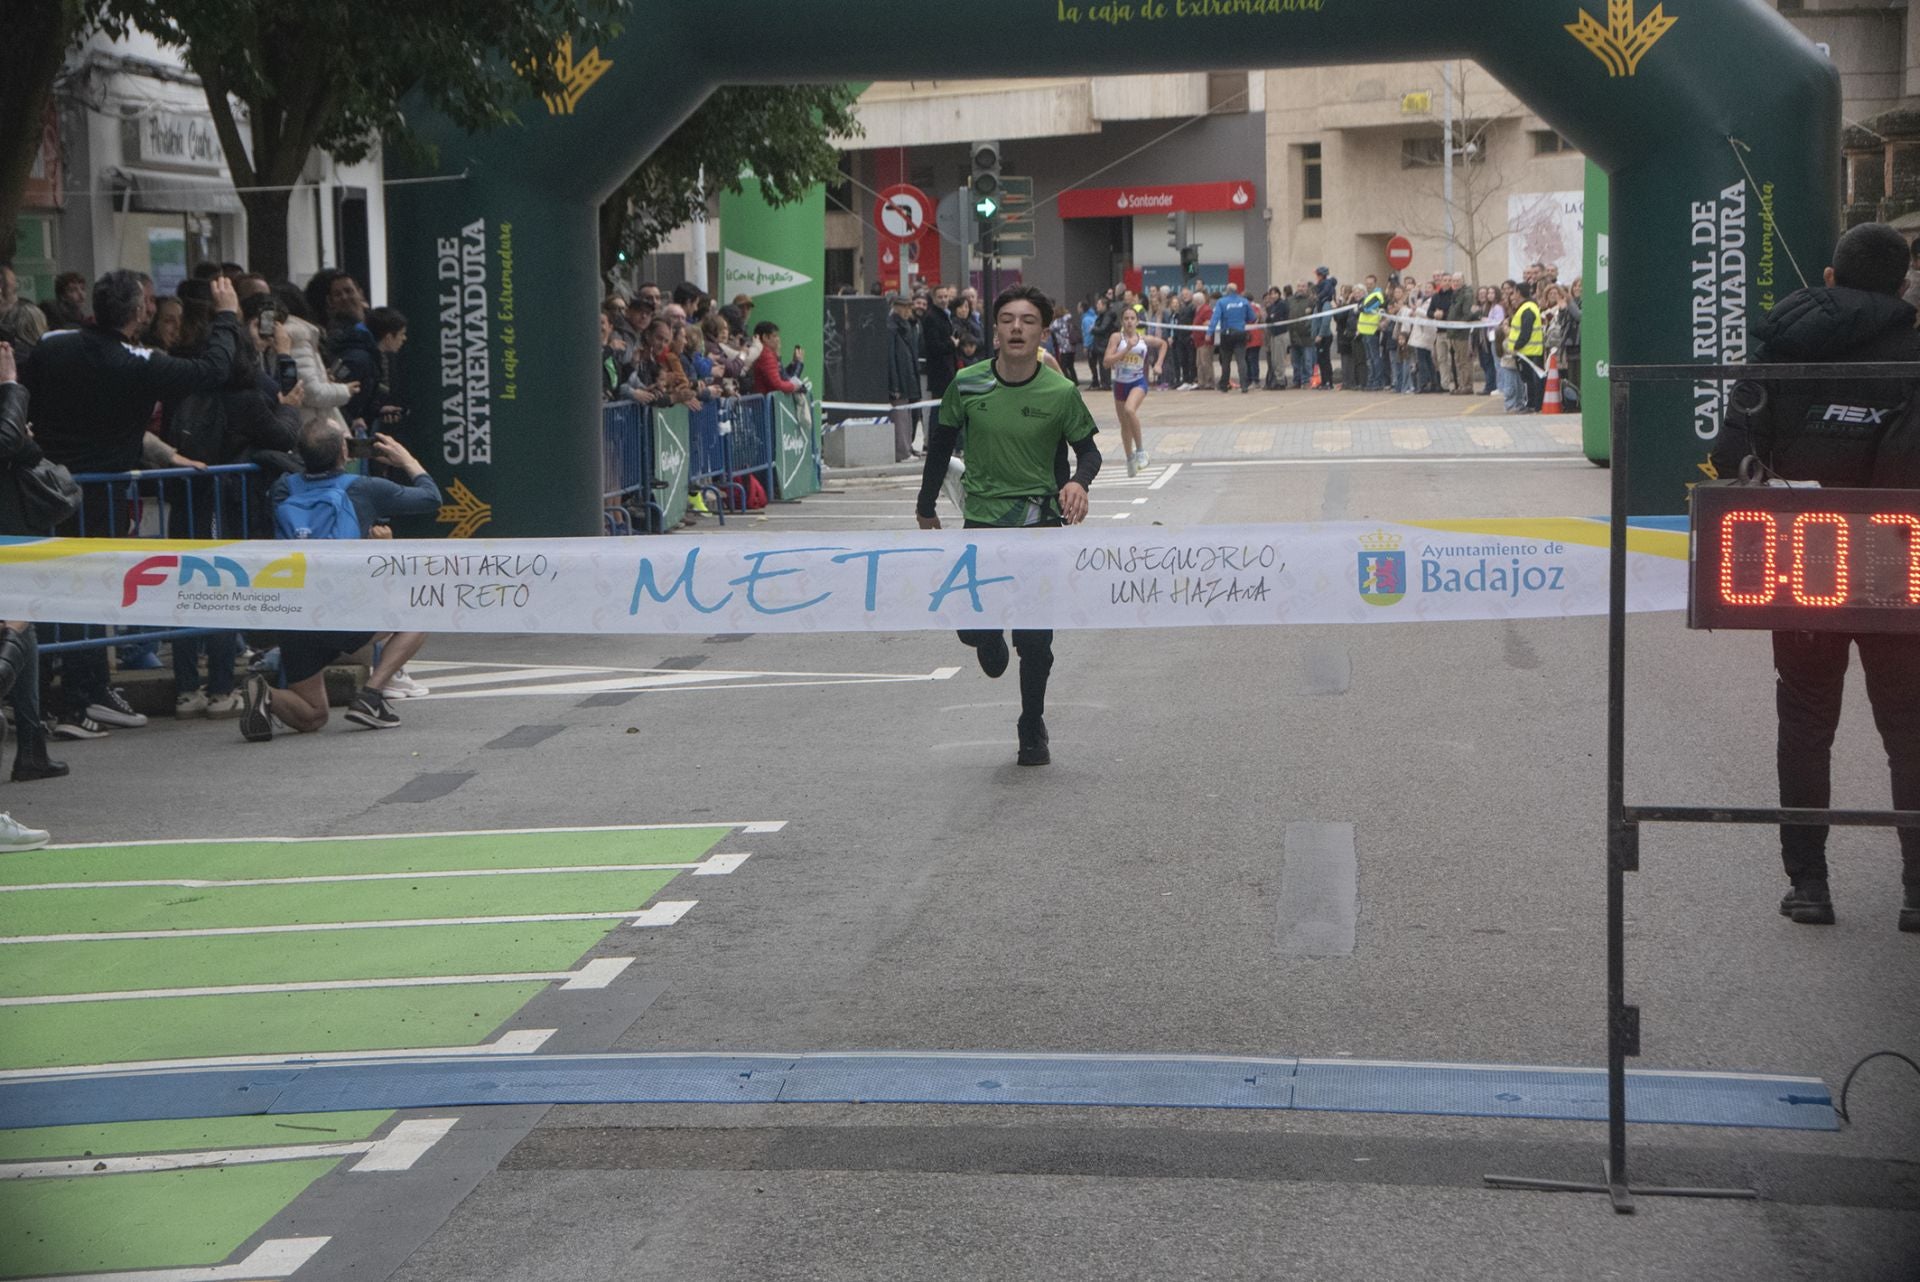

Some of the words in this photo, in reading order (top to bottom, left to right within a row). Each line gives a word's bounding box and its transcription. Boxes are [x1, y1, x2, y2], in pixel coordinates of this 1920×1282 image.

[1088, 0, 1135, 24] caja
[1141, 0, 1169, 19] de
[1128, 193, 1174, 209] Santander
[1691, 200, 1717, 246] DE
[1757, 181, 1774, 286] Extremadura
[437, 237, 461, 280] DE
[498, 221, 514, 321] Extremadura
[1691, 251, 1718, 359] RURAL
[1758, 291, 1774, 311] de
[440, 285, 464, 388] RURAL
[461, 217, 492, 465] EXTREMADURA
[500, 325, 515, 344] de
[501, 349, 520, 379] caja
[443, 391, 467, 465] CAJA
[1422, 543, 1538, 558] Ayuntamiento
[1544, 542, 1564, 555] de
[629, 544, 1015, 616] META
[1111, 577, 1164, 604] UNA
[1420, 558, 1565, 597] Badajoz
[176, 602, 190, 610] de
[193, 602, 241, 612] Deportes
[243, 603, 258, 612] de
[260, 603, 303, 615] Badajoz
[178, 590, 229, 601] Fundación
[232, 591, 280, 603] Municipal
[410, 583, 445, 608] UN
[454, 583, 530, 610] RETO
